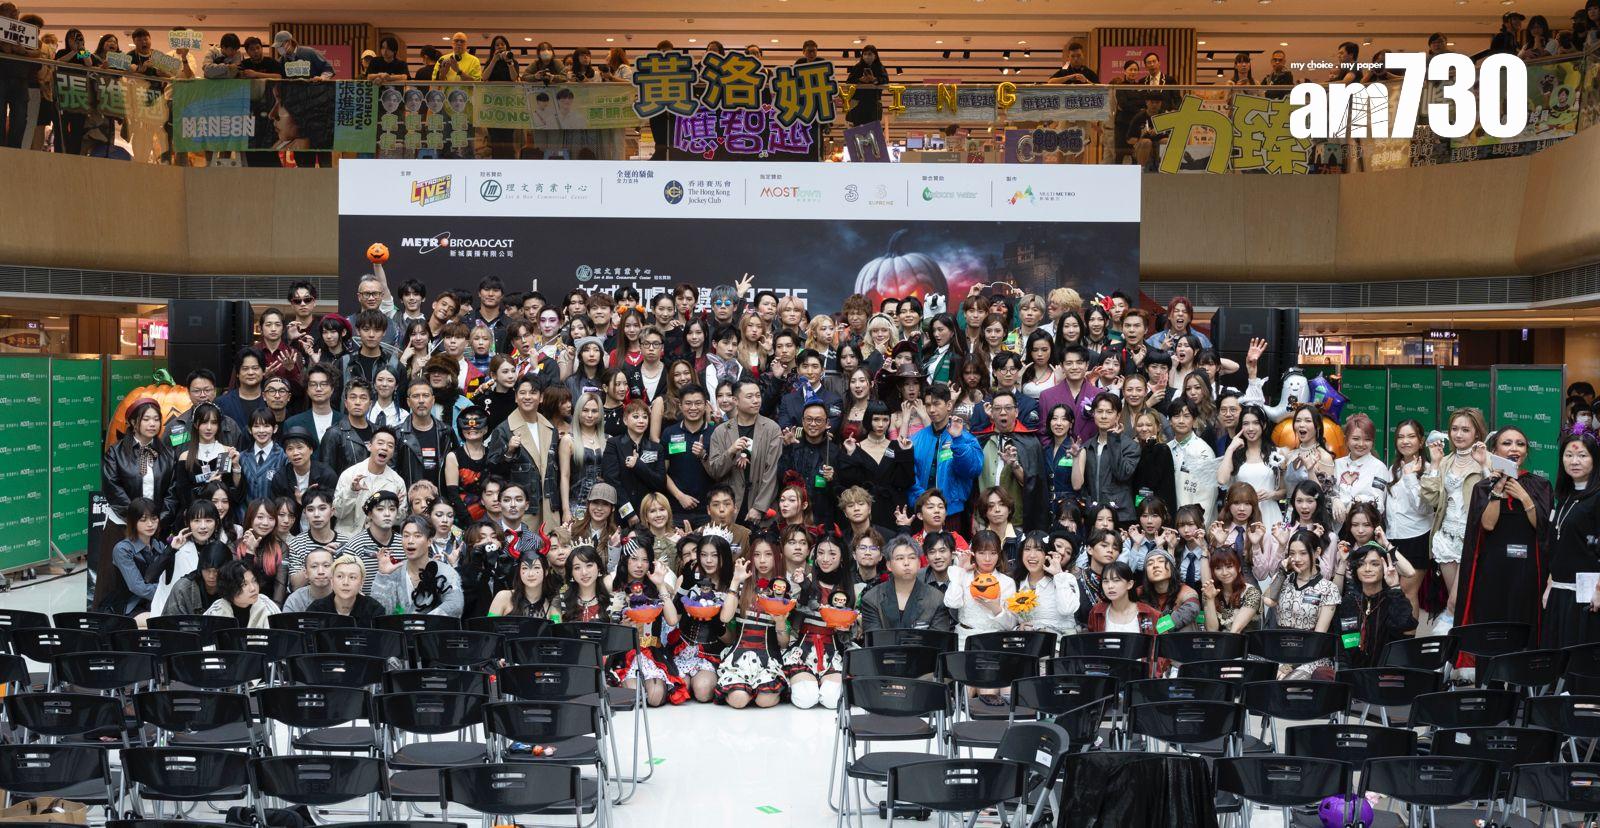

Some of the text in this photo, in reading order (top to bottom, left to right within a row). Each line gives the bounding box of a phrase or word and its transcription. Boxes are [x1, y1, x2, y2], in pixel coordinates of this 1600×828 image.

[633, 51, 837, 127] 黃洛妍
[355, 81, 364, 130] MANSON
[364, 81, 373, 126] CHEUNG
[483, 94, 526, 107] DARK
[480, 110, 530, 122] WONG
[505, 183, 588, 193] 理文商業中心
[688, 180, 731, 188] 香港賽馬會
[700, 188, 715, 196] Hong
[716, 188, 731, 197] Kong
[844, 184, 859, 202] 3
[688, 197, 707, 205] Jockey
[450, 239, 514, 248] BROADCAST
[450, 250, 514, 258] 新城廣播有限公司
